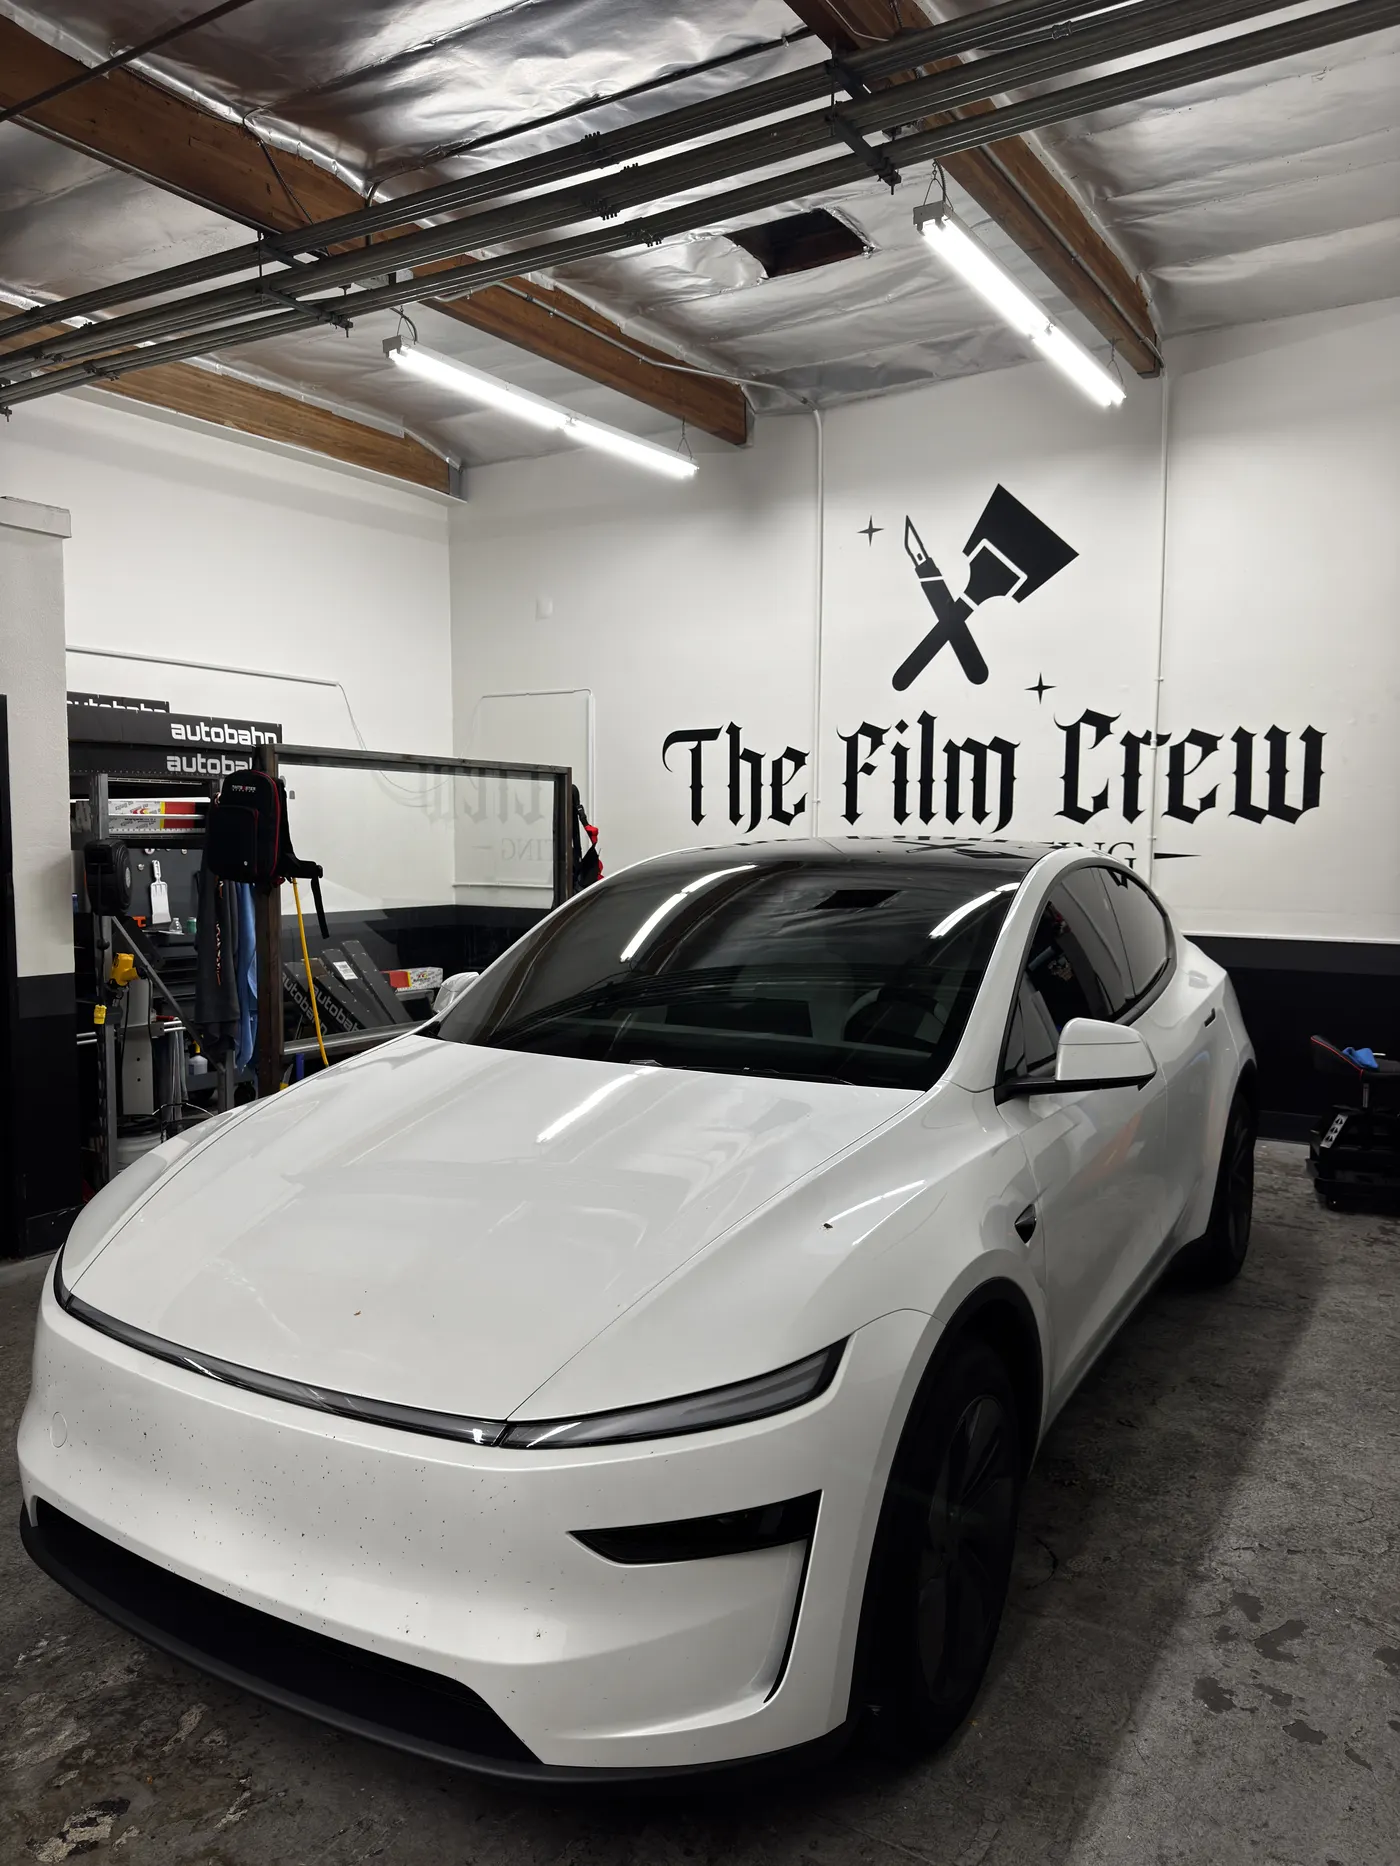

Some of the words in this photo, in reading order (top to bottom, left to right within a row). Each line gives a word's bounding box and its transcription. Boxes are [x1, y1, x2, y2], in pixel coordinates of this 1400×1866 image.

[170, 721, 277, 745] autobahn
[662, 721, 810, 834] The
[836, 710, 1021, 834] Film
[1053, 708, 1327, 824] Crew
